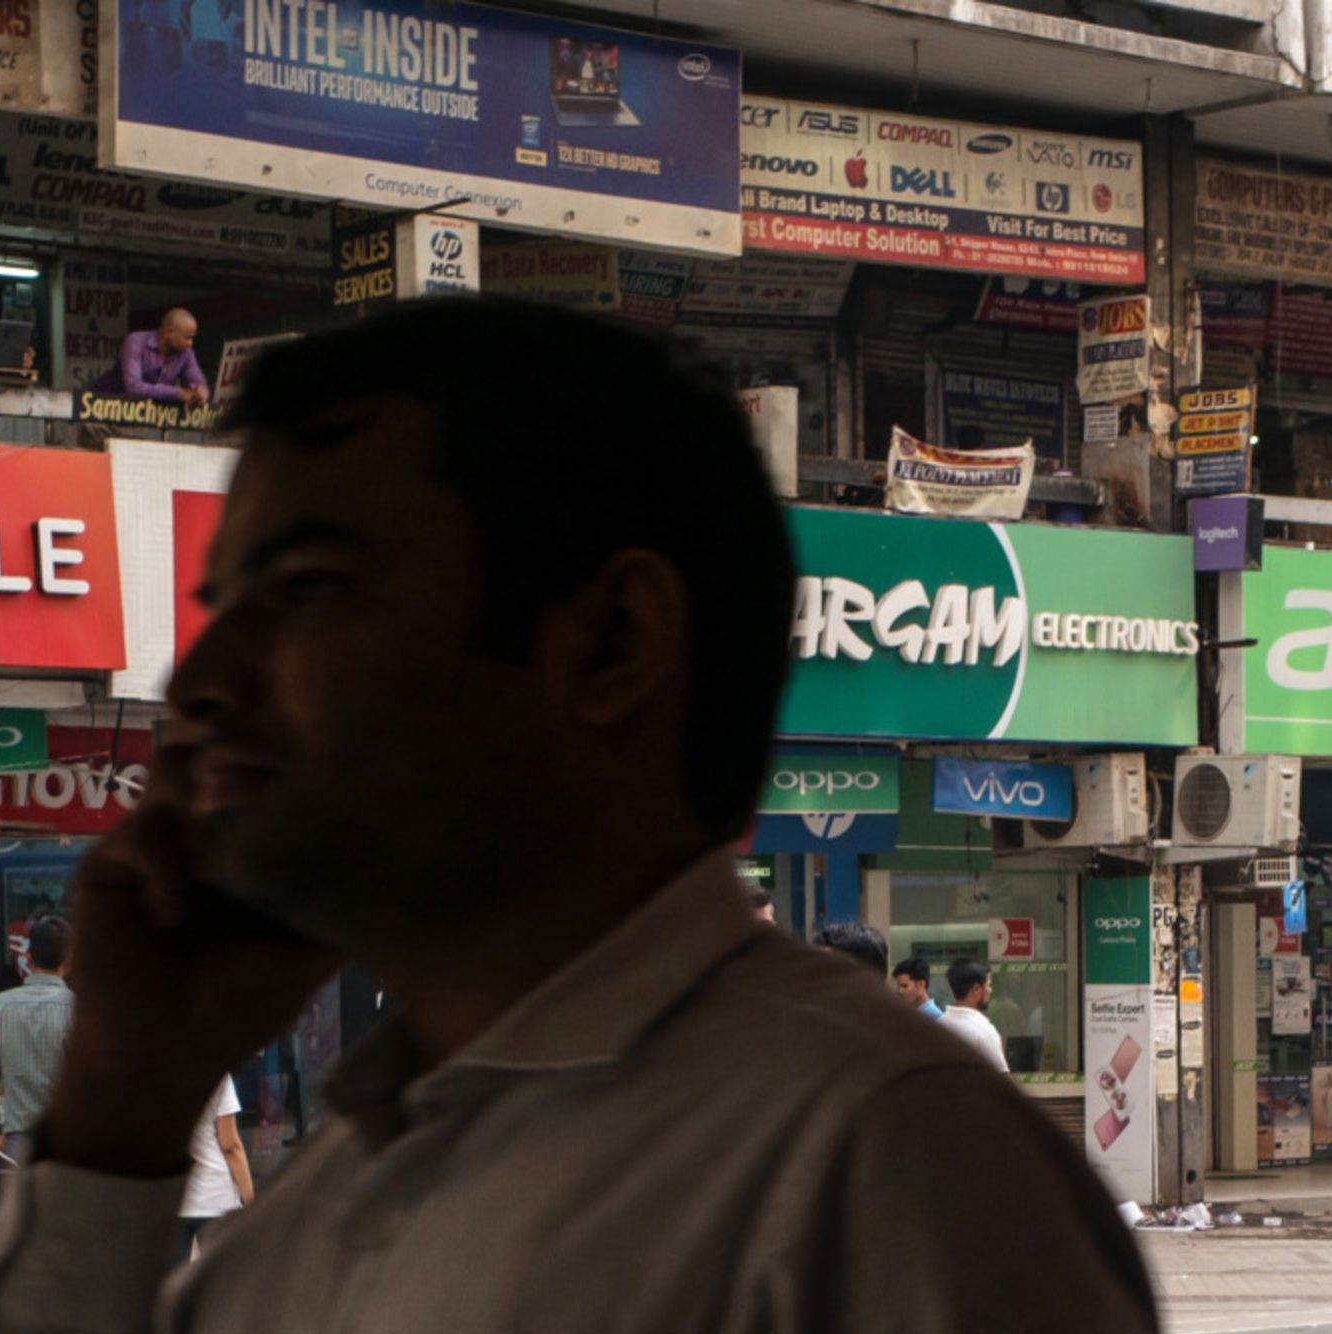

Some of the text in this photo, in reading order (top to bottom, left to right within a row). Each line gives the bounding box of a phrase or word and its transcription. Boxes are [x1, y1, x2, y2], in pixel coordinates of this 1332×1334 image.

[244, 0, 479, 91] INTEL INSIDE
[244, 58, 479, 121] BRILLIANT PERFORMANCE OUTSIDE
[742, 107, 1135, 171] cer ASUS COMPAQ msi
[31, 174, 148, 212] COMPAQ
[366, 172, 522, 211] Computer Connexion
[741, 151, 820, 178] enovo
[890, 165, 956, 198] DELL
[741, 216, 942, 257] rst Computer Solution
[759, 190, 807, 213] Brand
[810, 195, 867, 222] Laptop
[885, 202, 950, 230] Desktop
[987, 214, 1022, 238] Visit
[1025, 218, 1050, 240] For
[1052, 222, 1087, 244] Best
[1088, 226, 1128, 249] Price
[340, 229, 392, 272] SALES
[538, 248, 609, 281] Recovery
[333, 267, 397, 306] SERVICES
[429, 262, 466, 279] HCL
[1099, 299, 1146, 335] JOBS
[79, 390, 179, 428] Samuchya
[1188, 391, 1239, 408] JOBS
[1198, 525, 1239, 545] logitech
[789, 576, 1200, 668] ARGAM ELECTRONICS
[773, 767, 881, 798] oppo
[963, 770, 1046, 808] vivo
[1094, 917, 1142, 931] oppo
[1091, 1002, 1146, 1016] Selfie Expert
